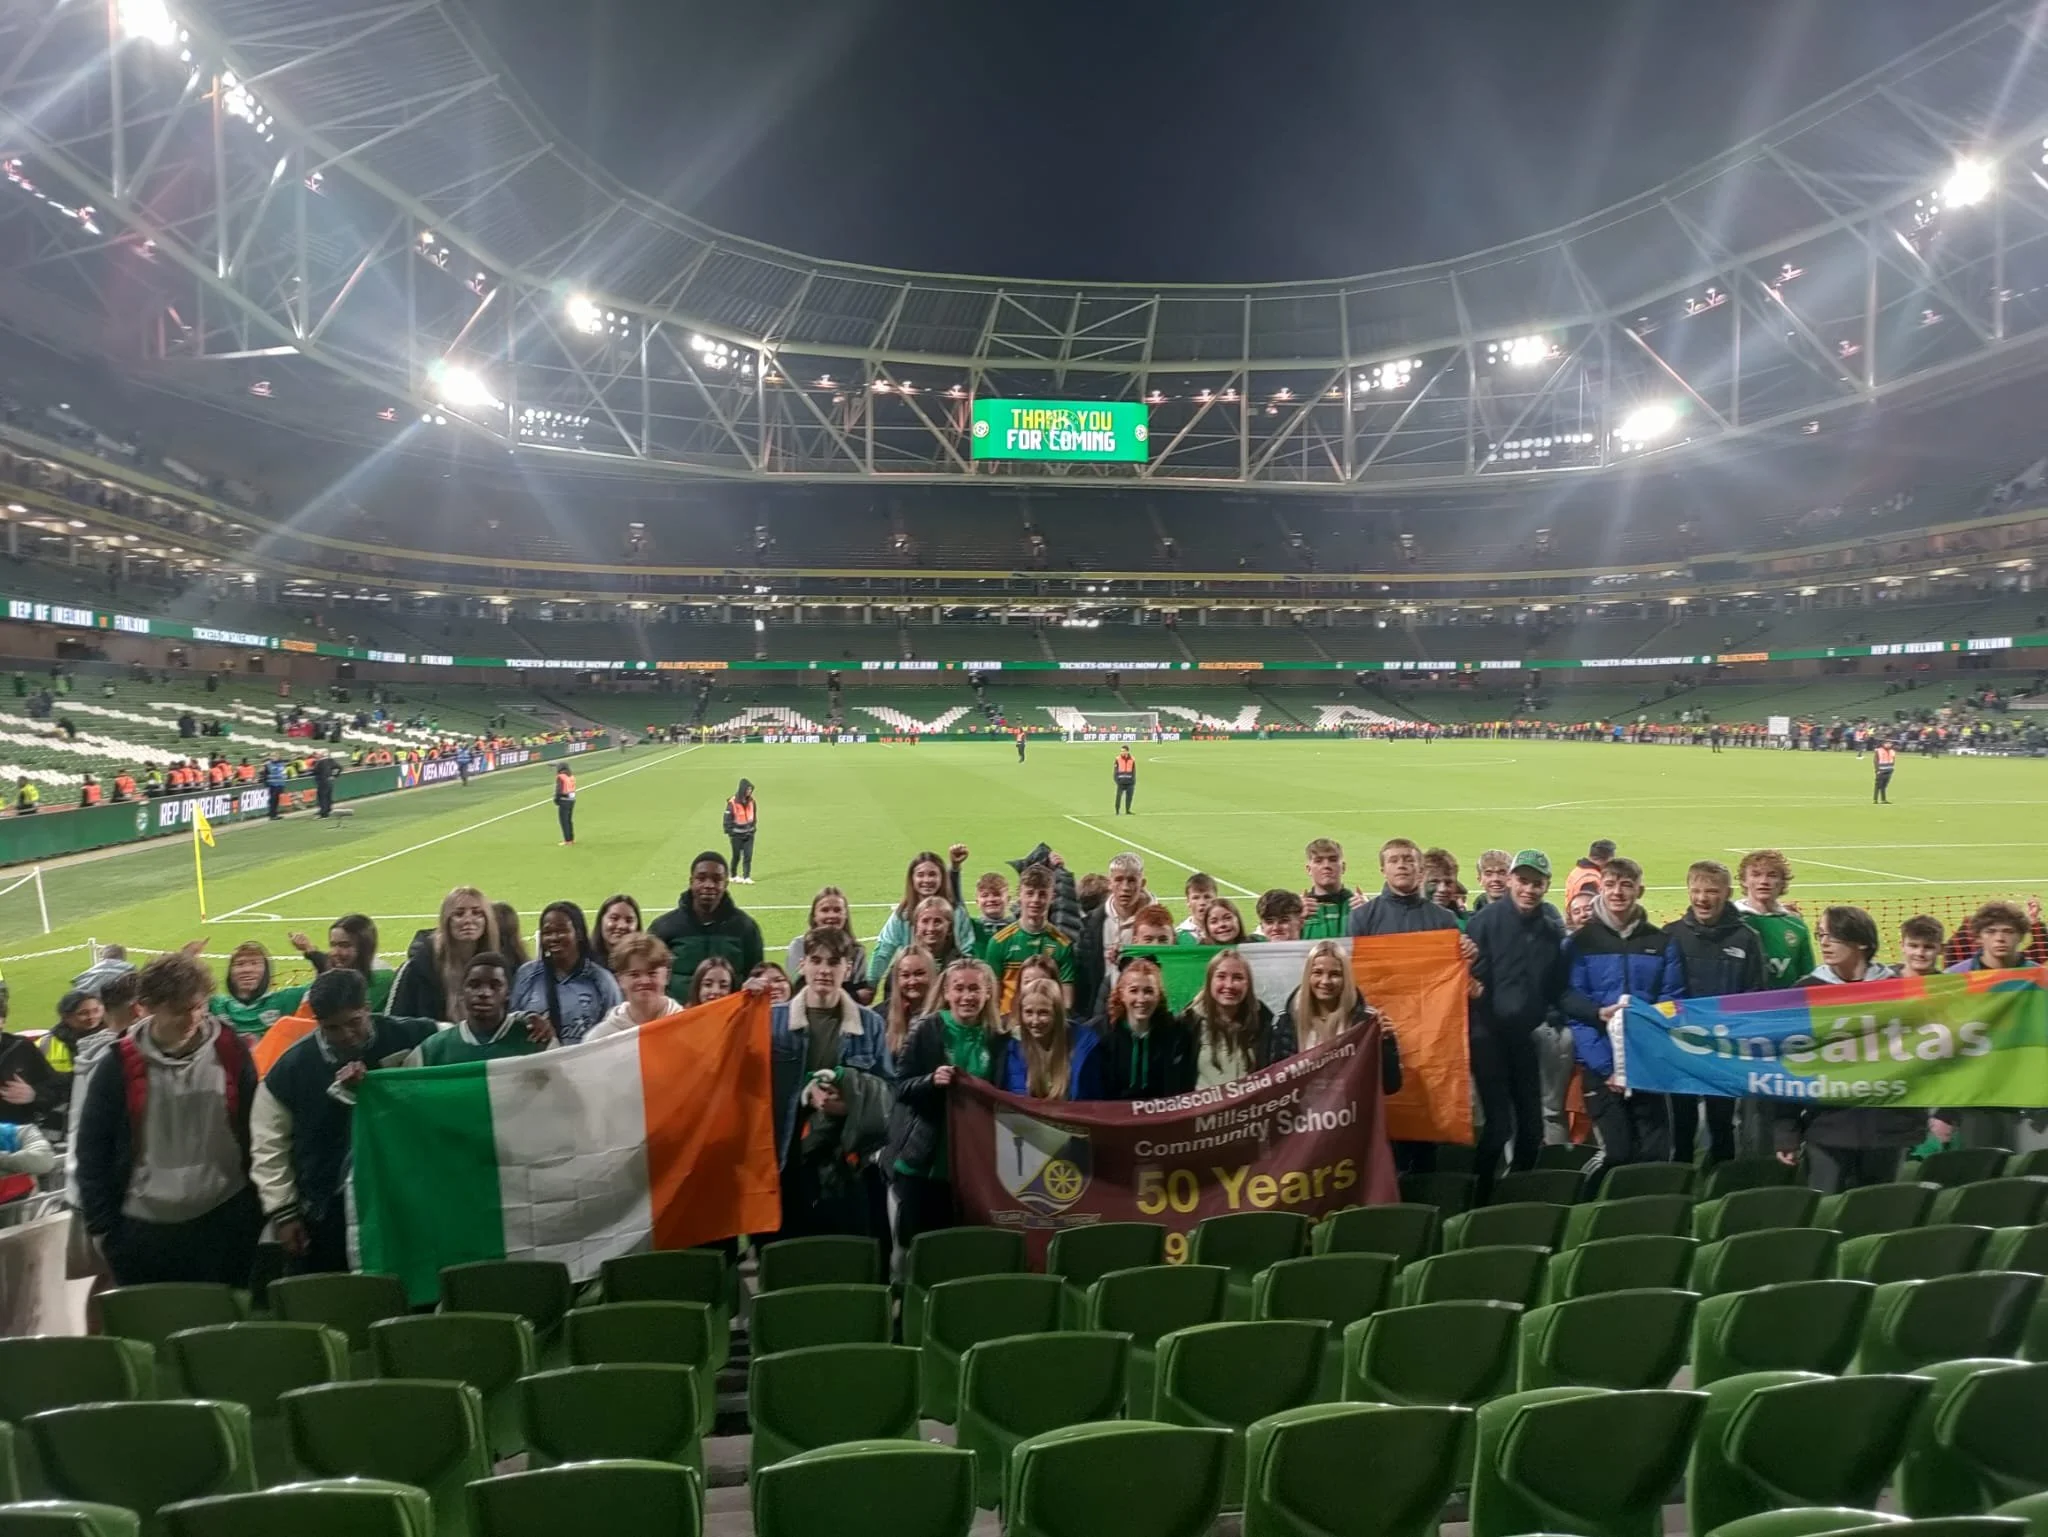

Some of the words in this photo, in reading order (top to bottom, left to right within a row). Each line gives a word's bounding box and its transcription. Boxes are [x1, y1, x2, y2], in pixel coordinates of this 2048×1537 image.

[1011, 408, 1069, 429] THANK
[1076, 410, 1113, 430] YOU
[1007, 429, 1042, 450] FOR
[1050, 431, 1116, 452] COMING
[423, 763, 438, 781] UEFA
[160, 801, 180, 827] REP
[1669, 1014, 1992, 1064] Cineáltas
[1224, 1075, 1273, 1100] Sráid
[1747, 1071, 1908, 1099] Kindness
[1195, 1087, 1301, 1134] Millstreet
[1134, 1119, 1270, 1158] Community
[1277, 1101, 1358, 1136] School
[1135, 1168, 1200, 1216] 50
[1210, 1157, 1358, 1210] Years
